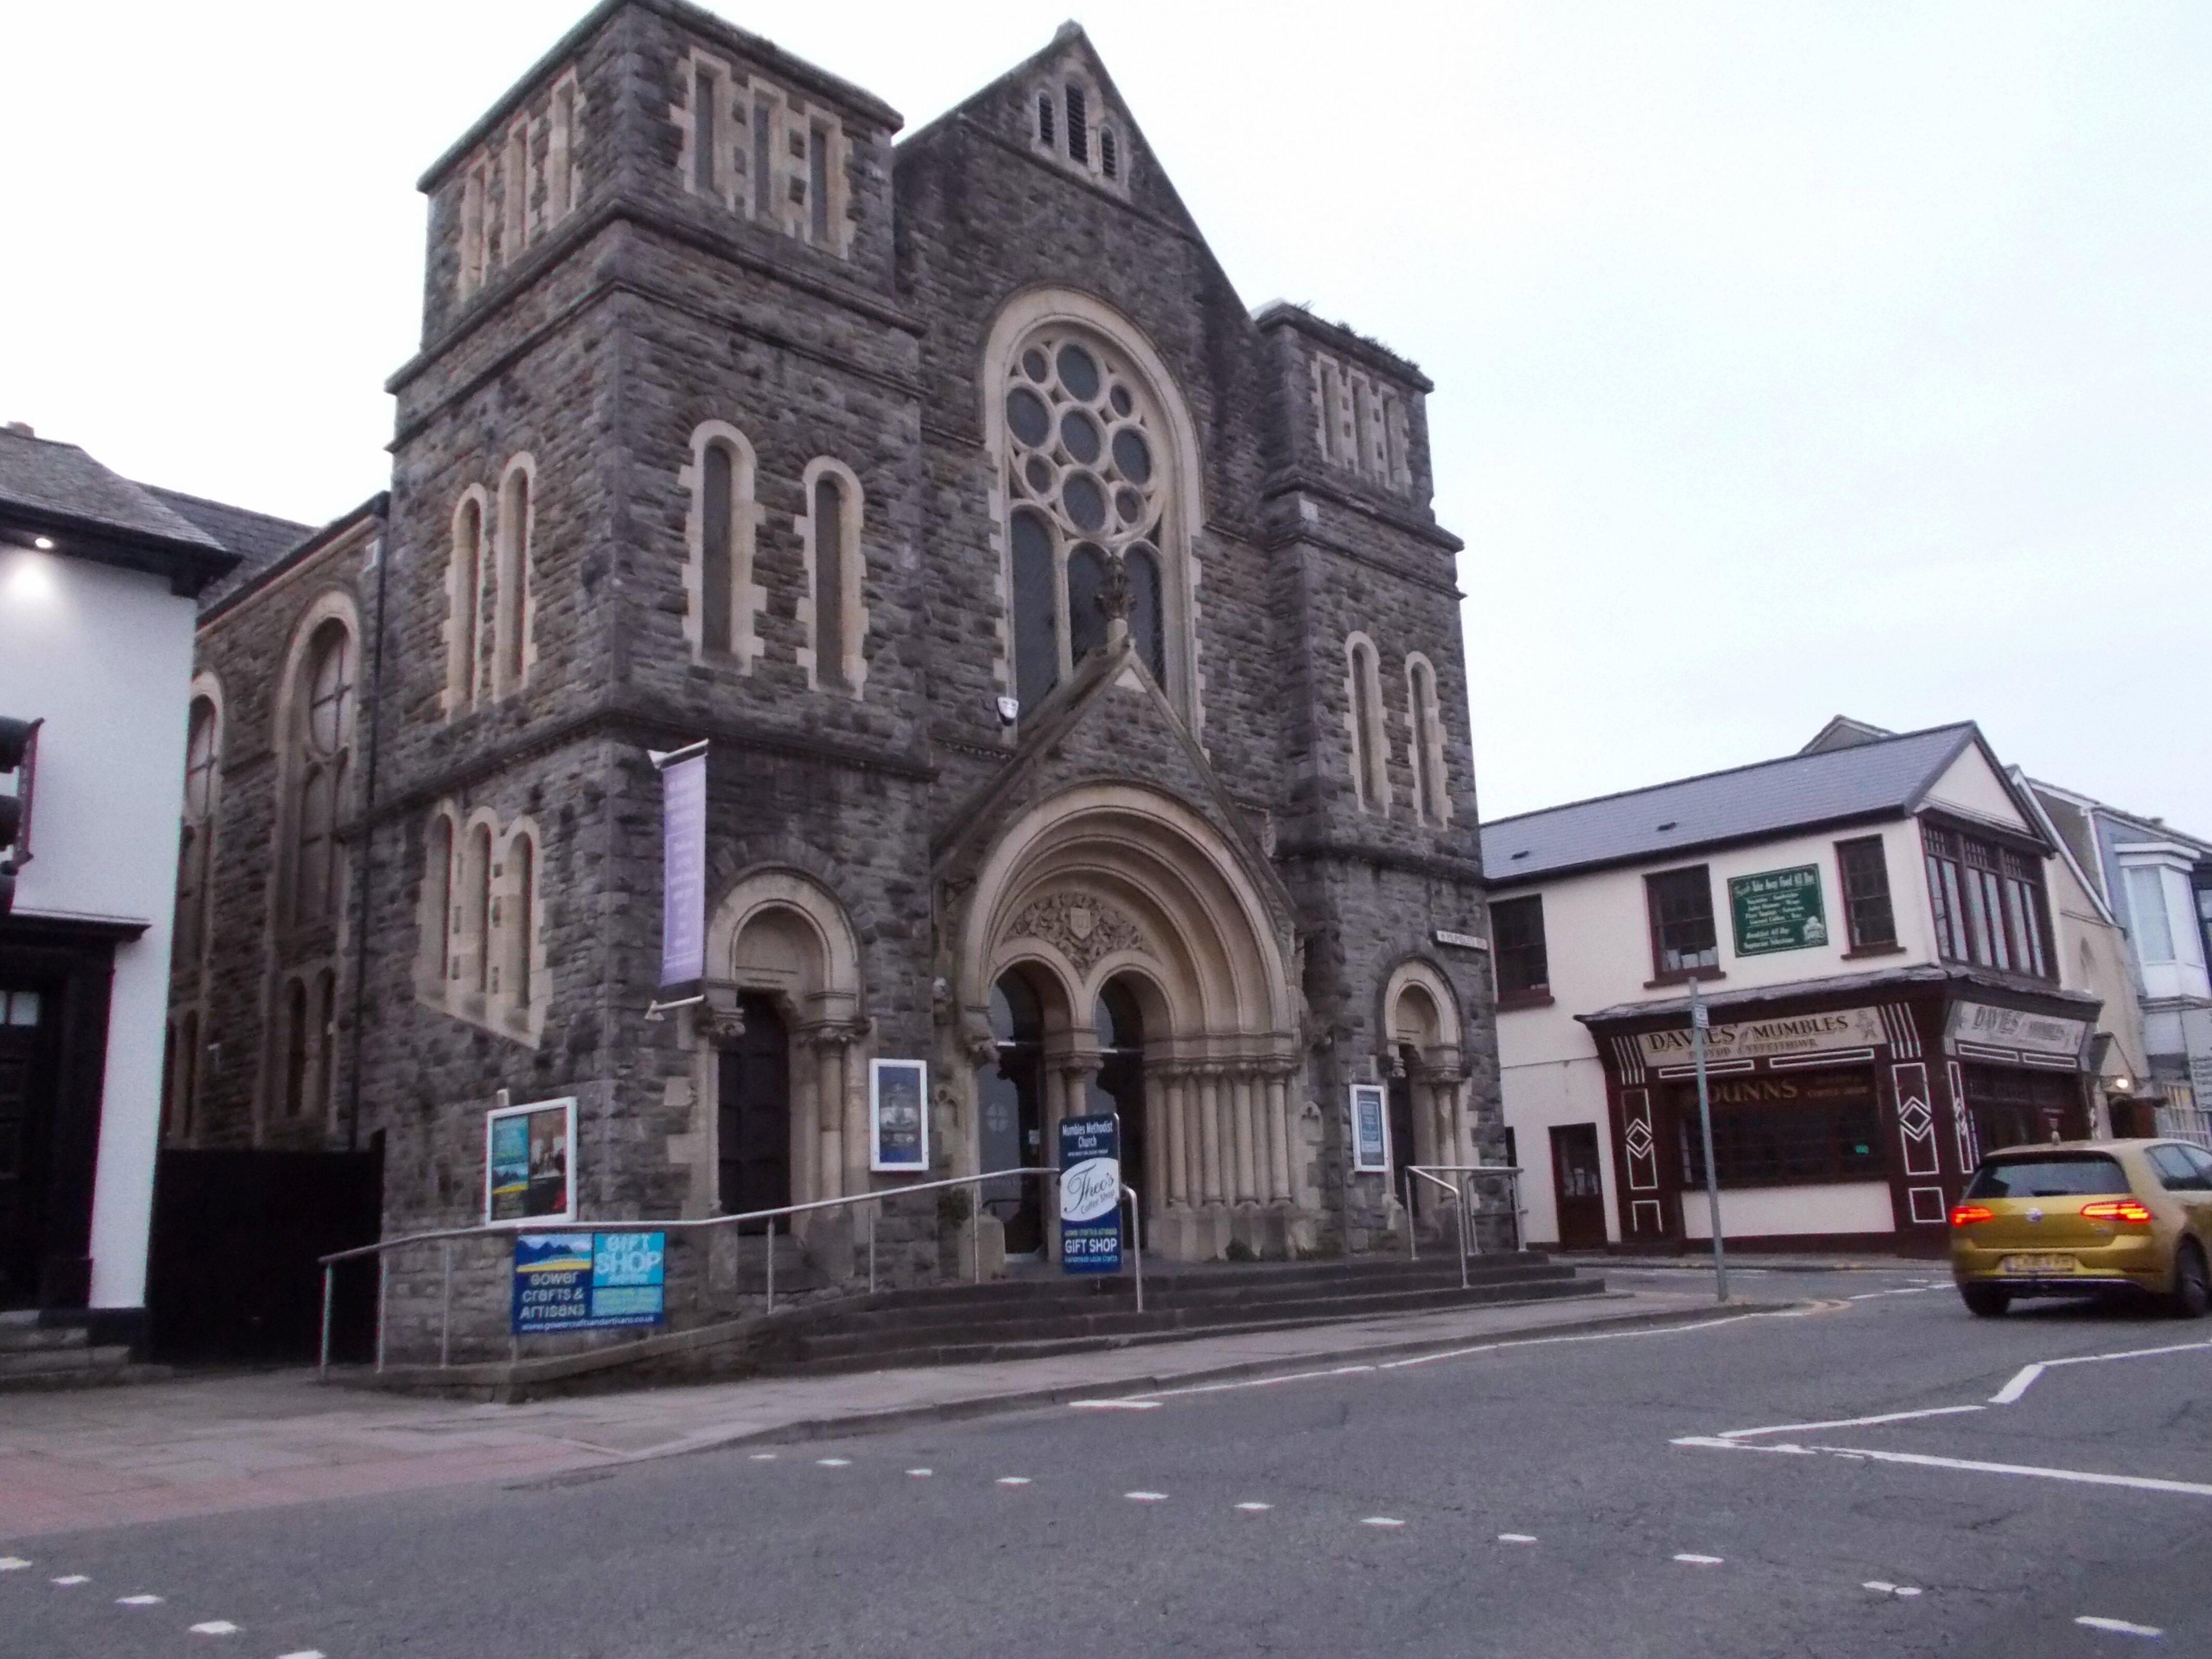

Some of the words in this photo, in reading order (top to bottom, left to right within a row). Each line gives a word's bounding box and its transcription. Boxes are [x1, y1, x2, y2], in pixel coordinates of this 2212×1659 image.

[1752, 1015, 1849, 1039] MUMBLES
[1062, 1123, 1085, 1136] Mumbles
[1086, 1121, 1113, 1134] Methodist
[1078, 1135, 1097, 1148] Church
[1064, 1163, 1115, 1213] Theo's
[1081, 1199, 1099, 1214] Coffee
[1100, 1190, 1115, 1203] Shop
[1065, 1239, 1087, 1253] GIFT
[1089, 1238, 1117, 1253] SHOP
[596, 1250, 662, 1274] SHOP
[573, 1287, 584, 1300] &
